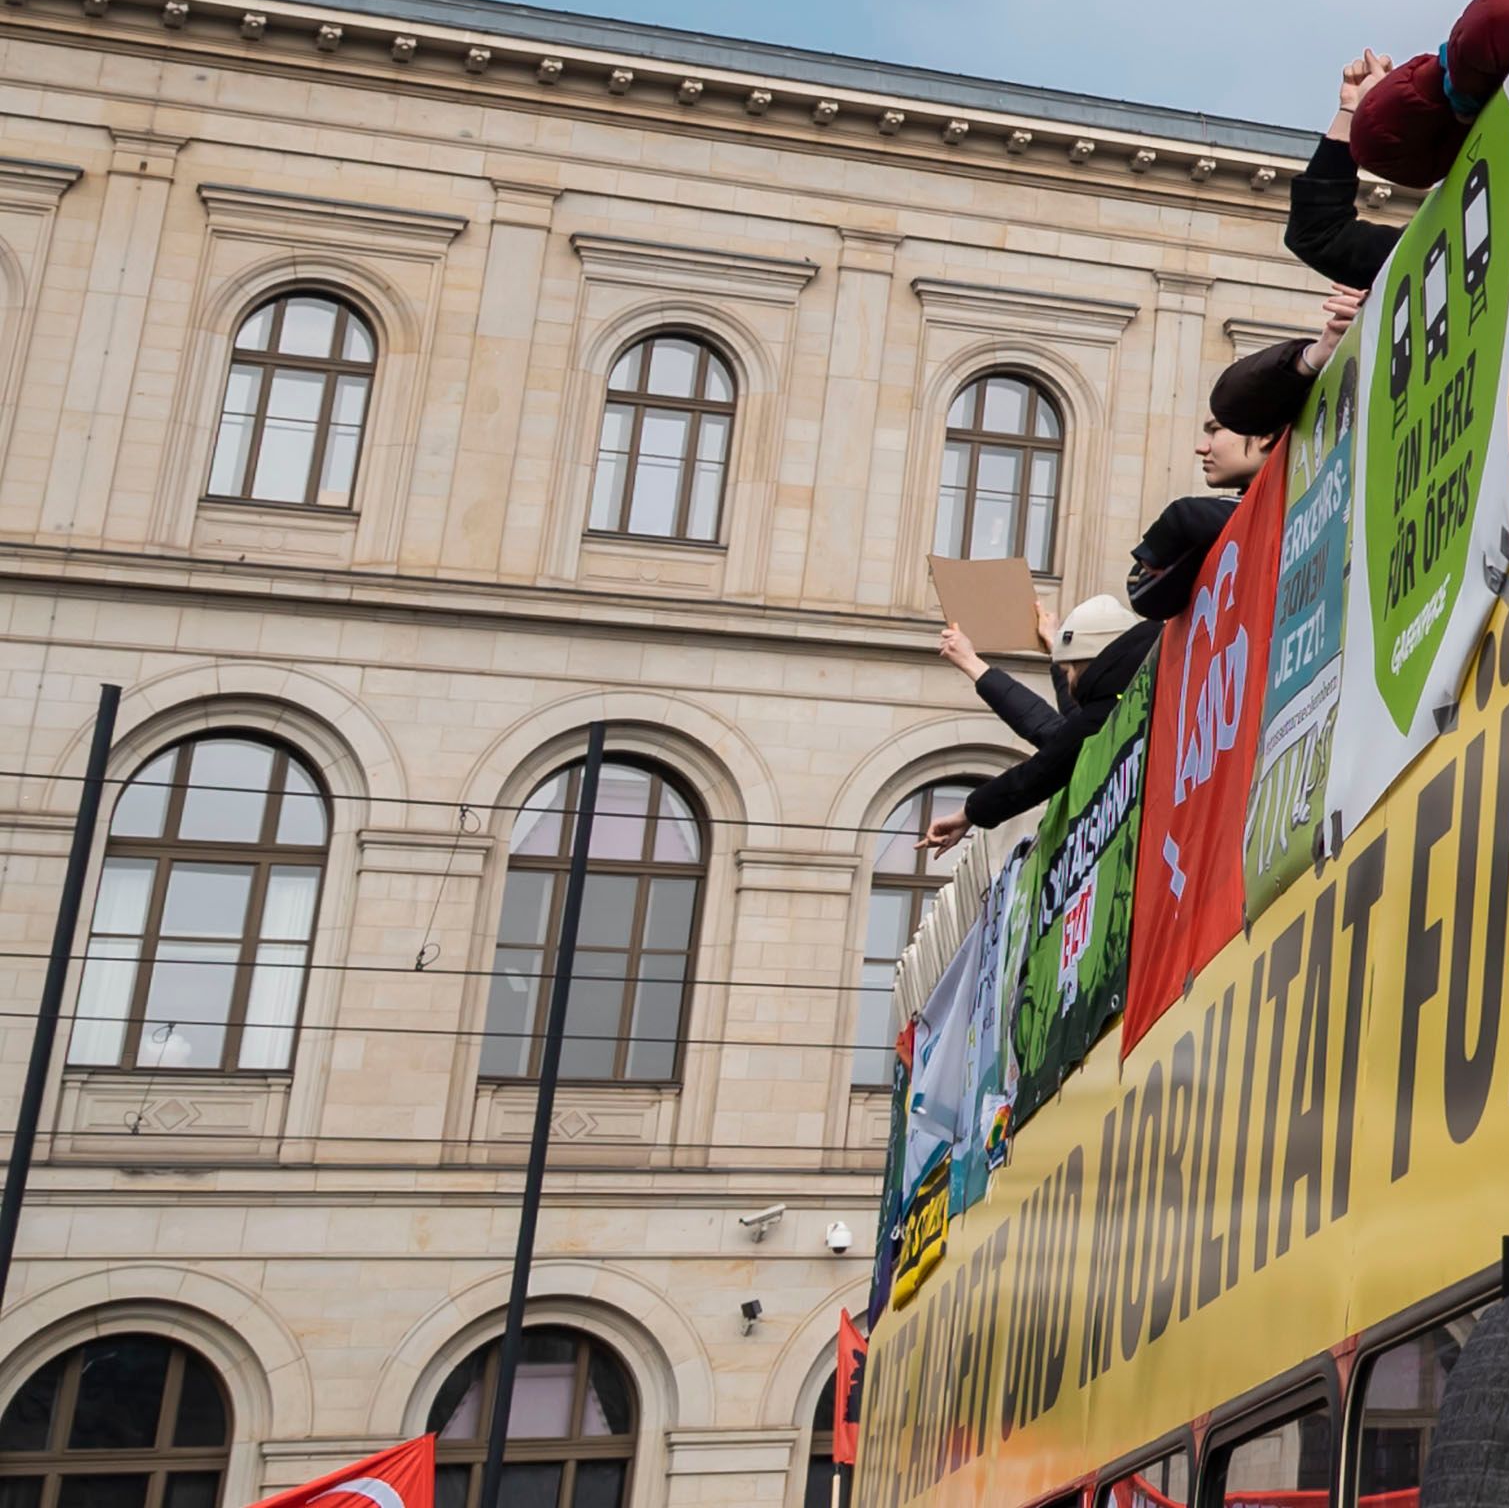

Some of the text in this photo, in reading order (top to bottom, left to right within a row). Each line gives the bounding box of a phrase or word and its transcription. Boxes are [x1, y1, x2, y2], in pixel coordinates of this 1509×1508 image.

[1393, 349, 1477, 518] EIN HERZ
[1279, 457, 1347, 581] ERKEHRS-
[1383, 449, 1473, 623] FÜR ÖFFIS
[1273, 598, 1326, 690] JETZT!
[904, 1218, 1010, 1504] ARBEIT
[1001, 1144, 1084, 1442] UND
